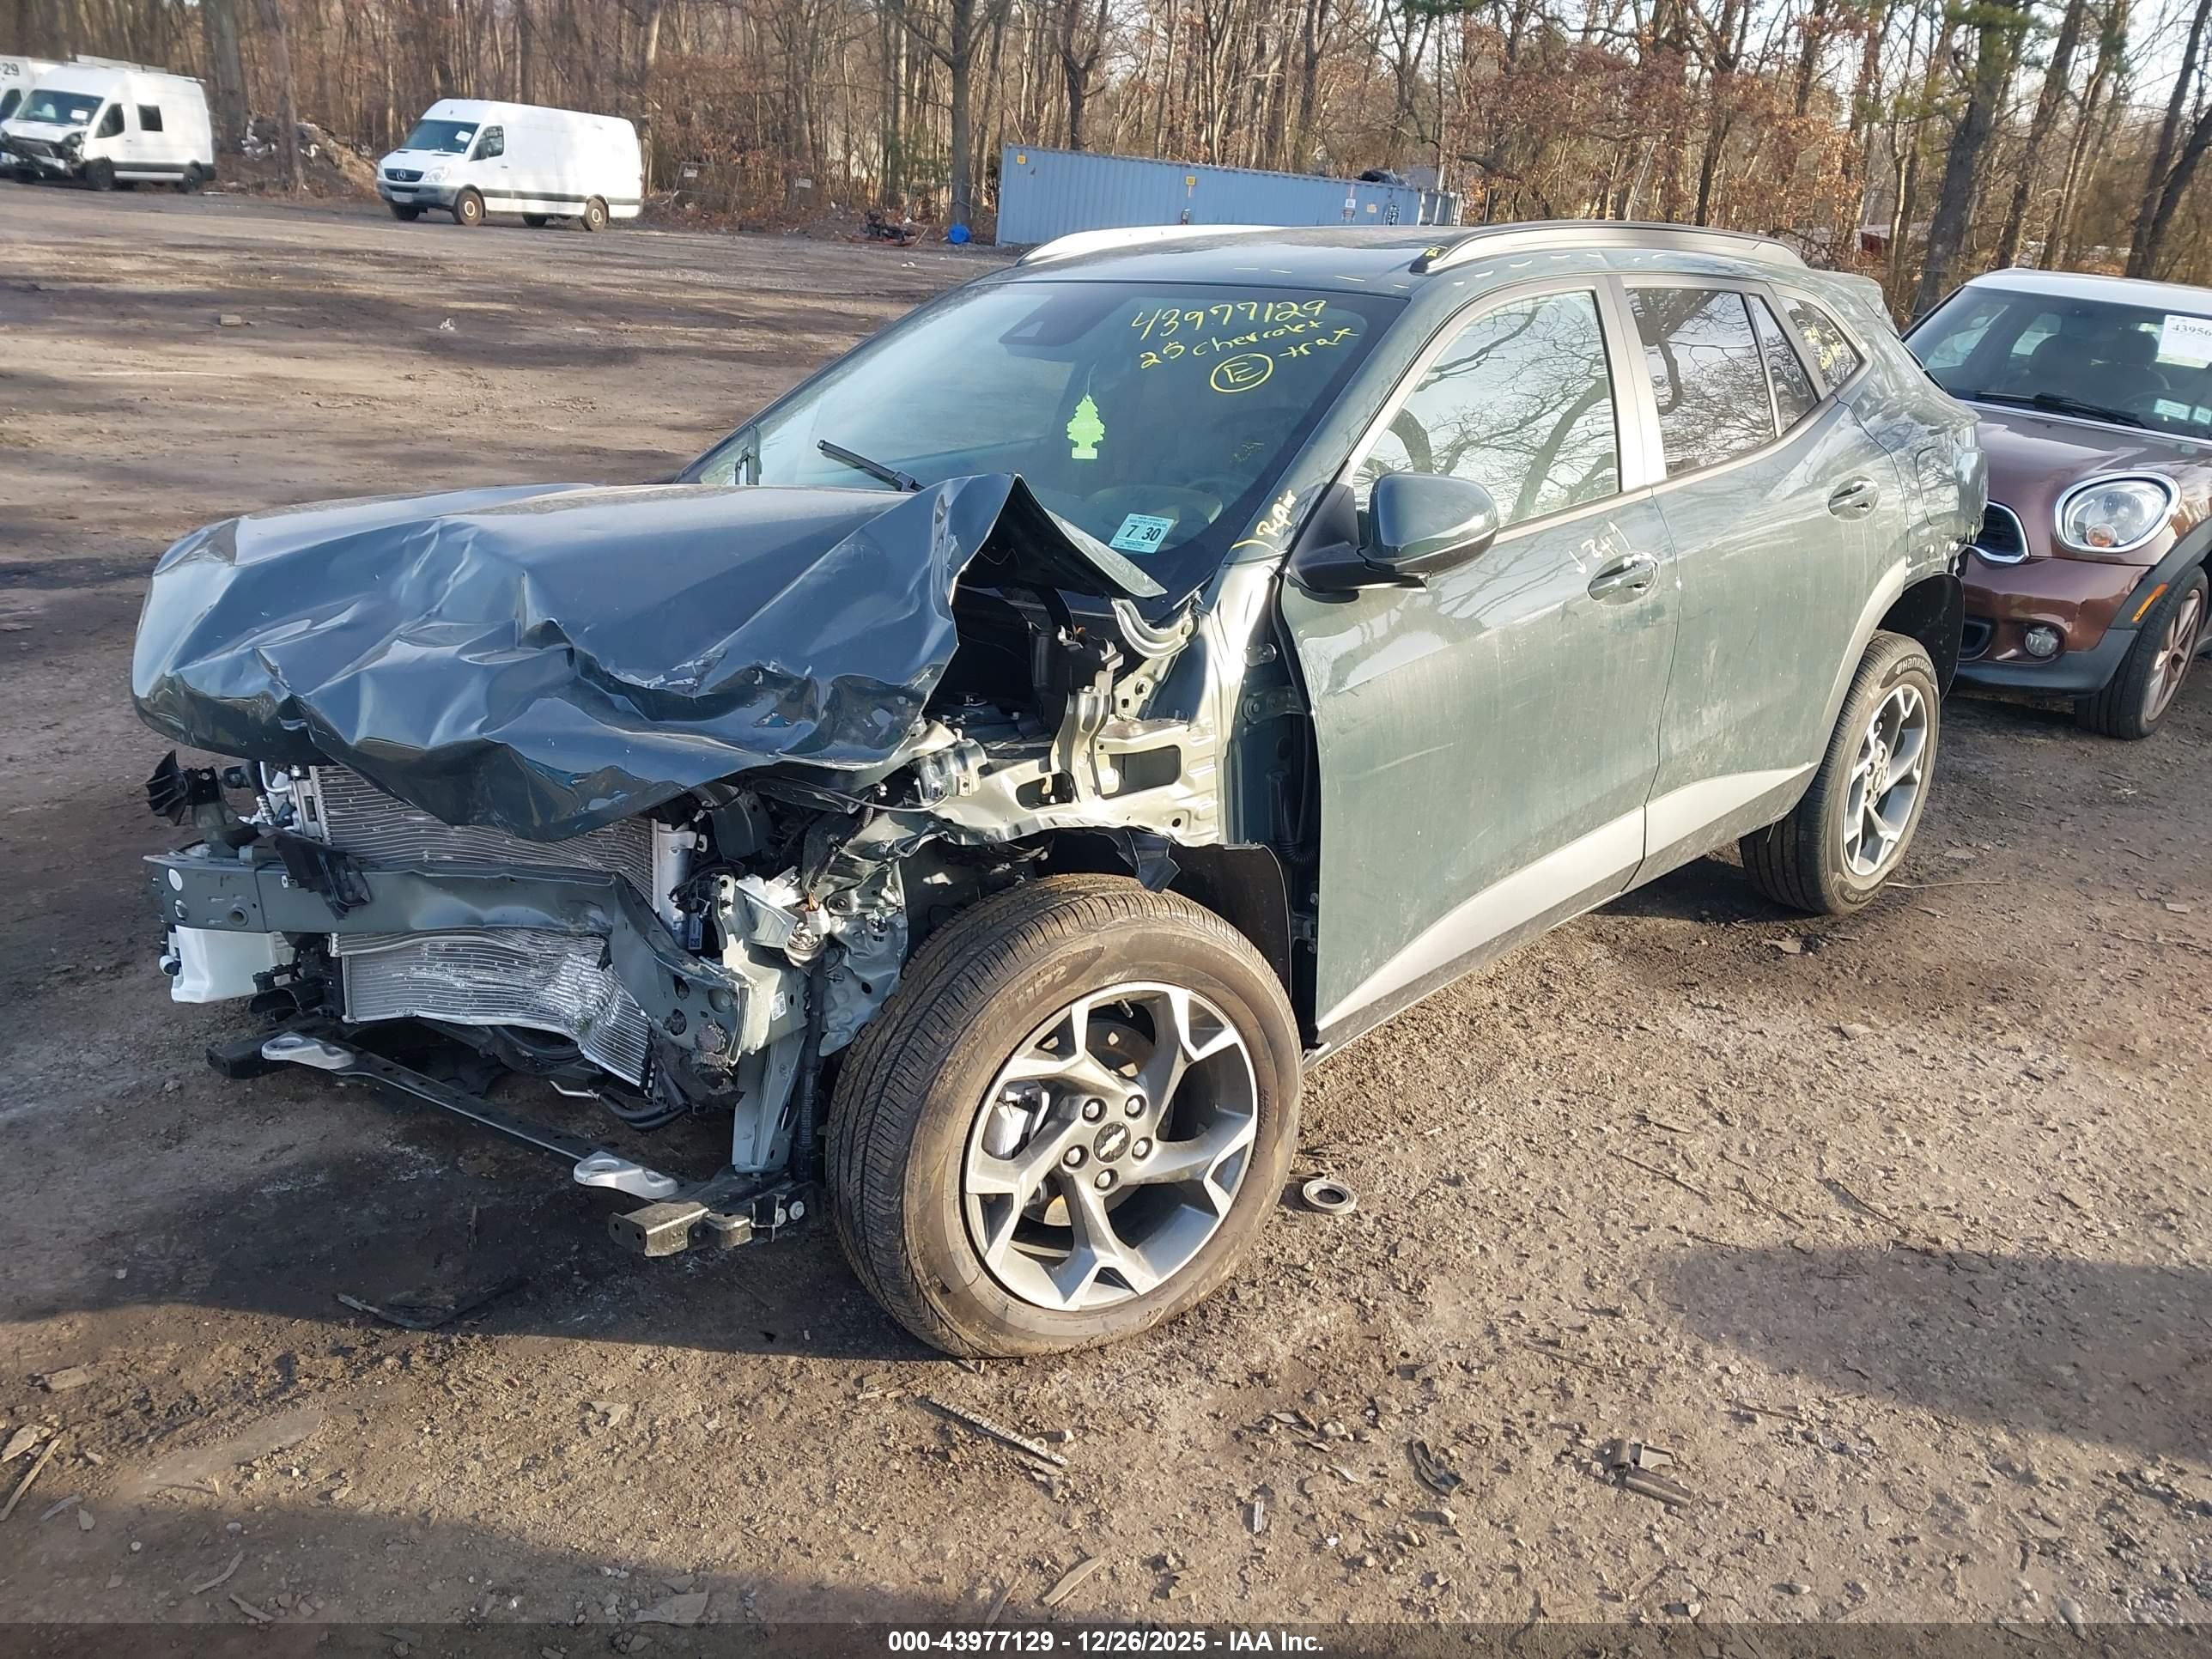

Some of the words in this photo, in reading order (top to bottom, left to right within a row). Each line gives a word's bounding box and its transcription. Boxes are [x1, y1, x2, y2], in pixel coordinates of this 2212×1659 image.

[1131, 300, 1327, 341] 43977129
[1125, 525, 1139, 538] 7
[1141, 526, 1162, 541] 30
